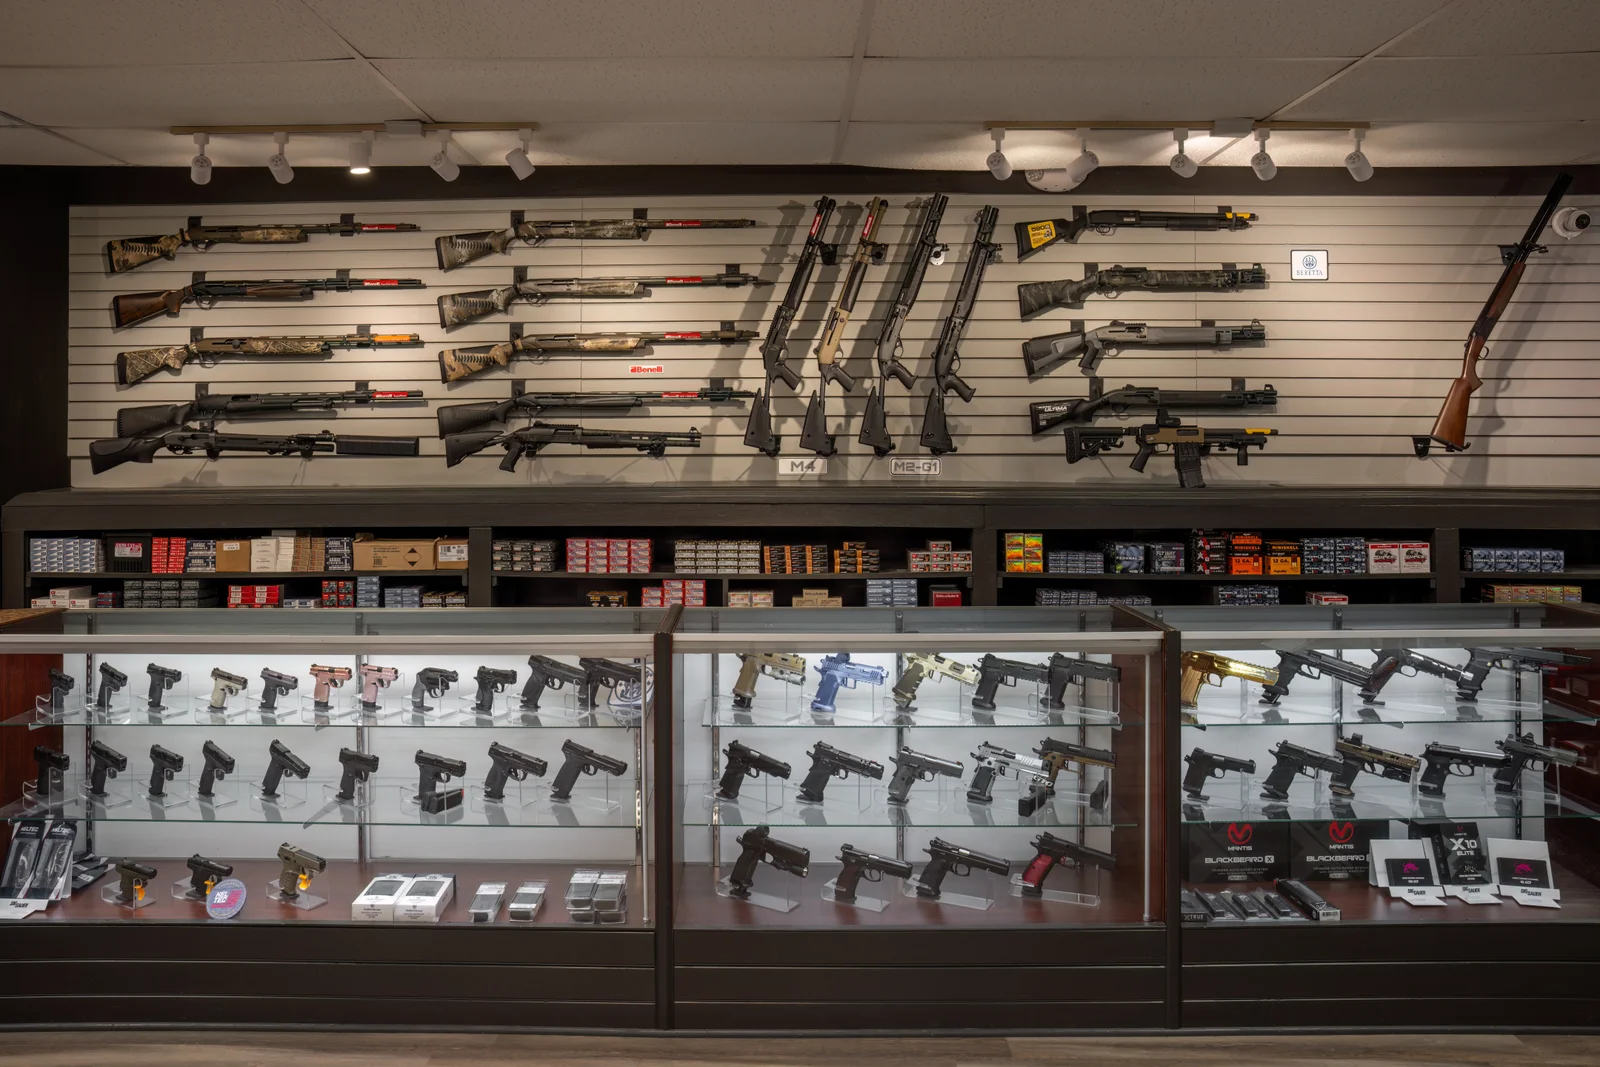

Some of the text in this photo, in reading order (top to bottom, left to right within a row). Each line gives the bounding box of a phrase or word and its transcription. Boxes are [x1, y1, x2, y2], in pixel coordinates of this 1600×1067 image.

[636, 365, 663, 373] Benelli
[790, 461, 816, 472] M4
[893, 462, 938, 472] M2-G1
[1450, 837, 1478, 851] X10
